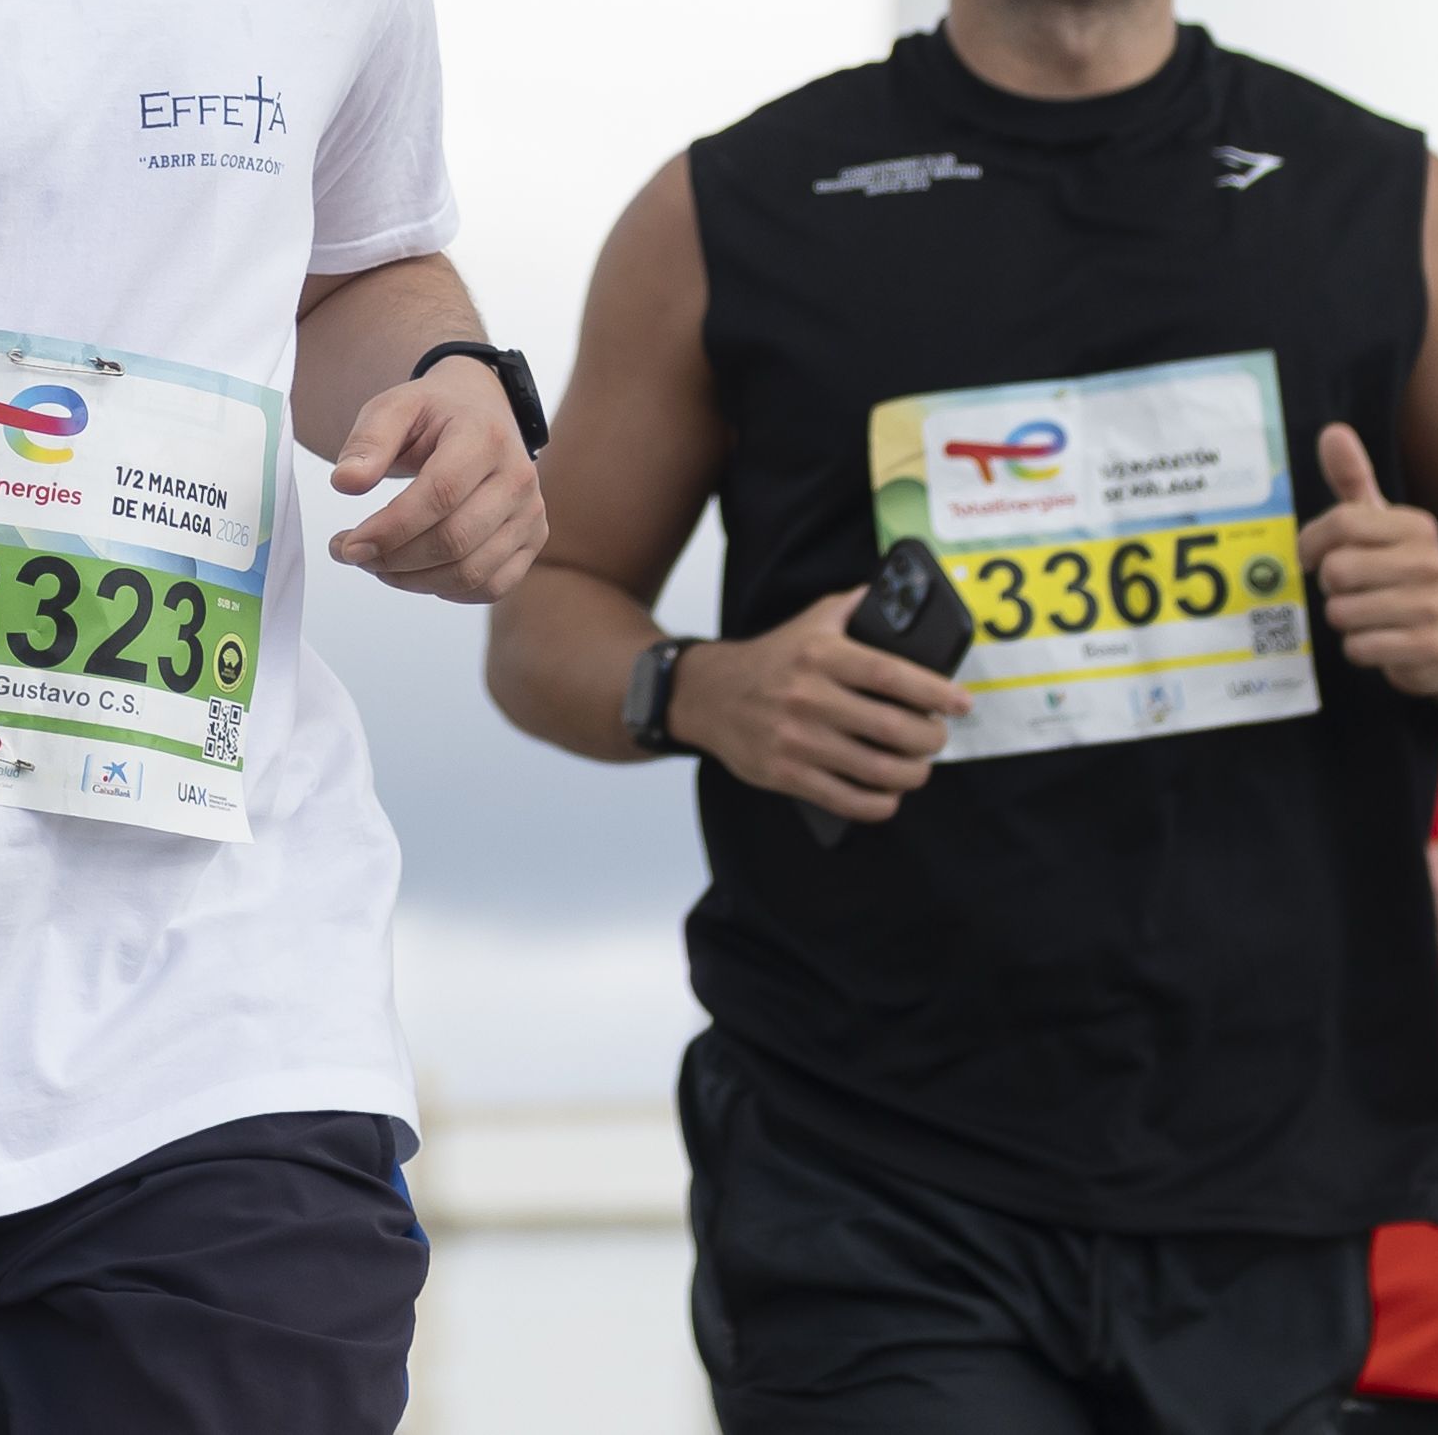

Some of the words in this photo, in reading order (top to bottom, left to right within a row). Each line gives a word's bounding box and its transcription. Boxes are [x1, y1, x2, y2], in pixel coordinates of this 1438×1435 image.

[201, 153, 217, 167] EL
[116, 466, 144, 490] 1/2
[148, 472, 228, 510] MARATÓN
[112, 496, 138, 519] DE
[142, 501, 212, 537] MÁLAGA
[216, 518, 251, 547] 2026
[977, 533, 1229, 642] 3365
[99, 690, 140, 715] C.S.
[92, 783, 132, 799] CaixaBank
[178, 781, 208, 807] UAX
